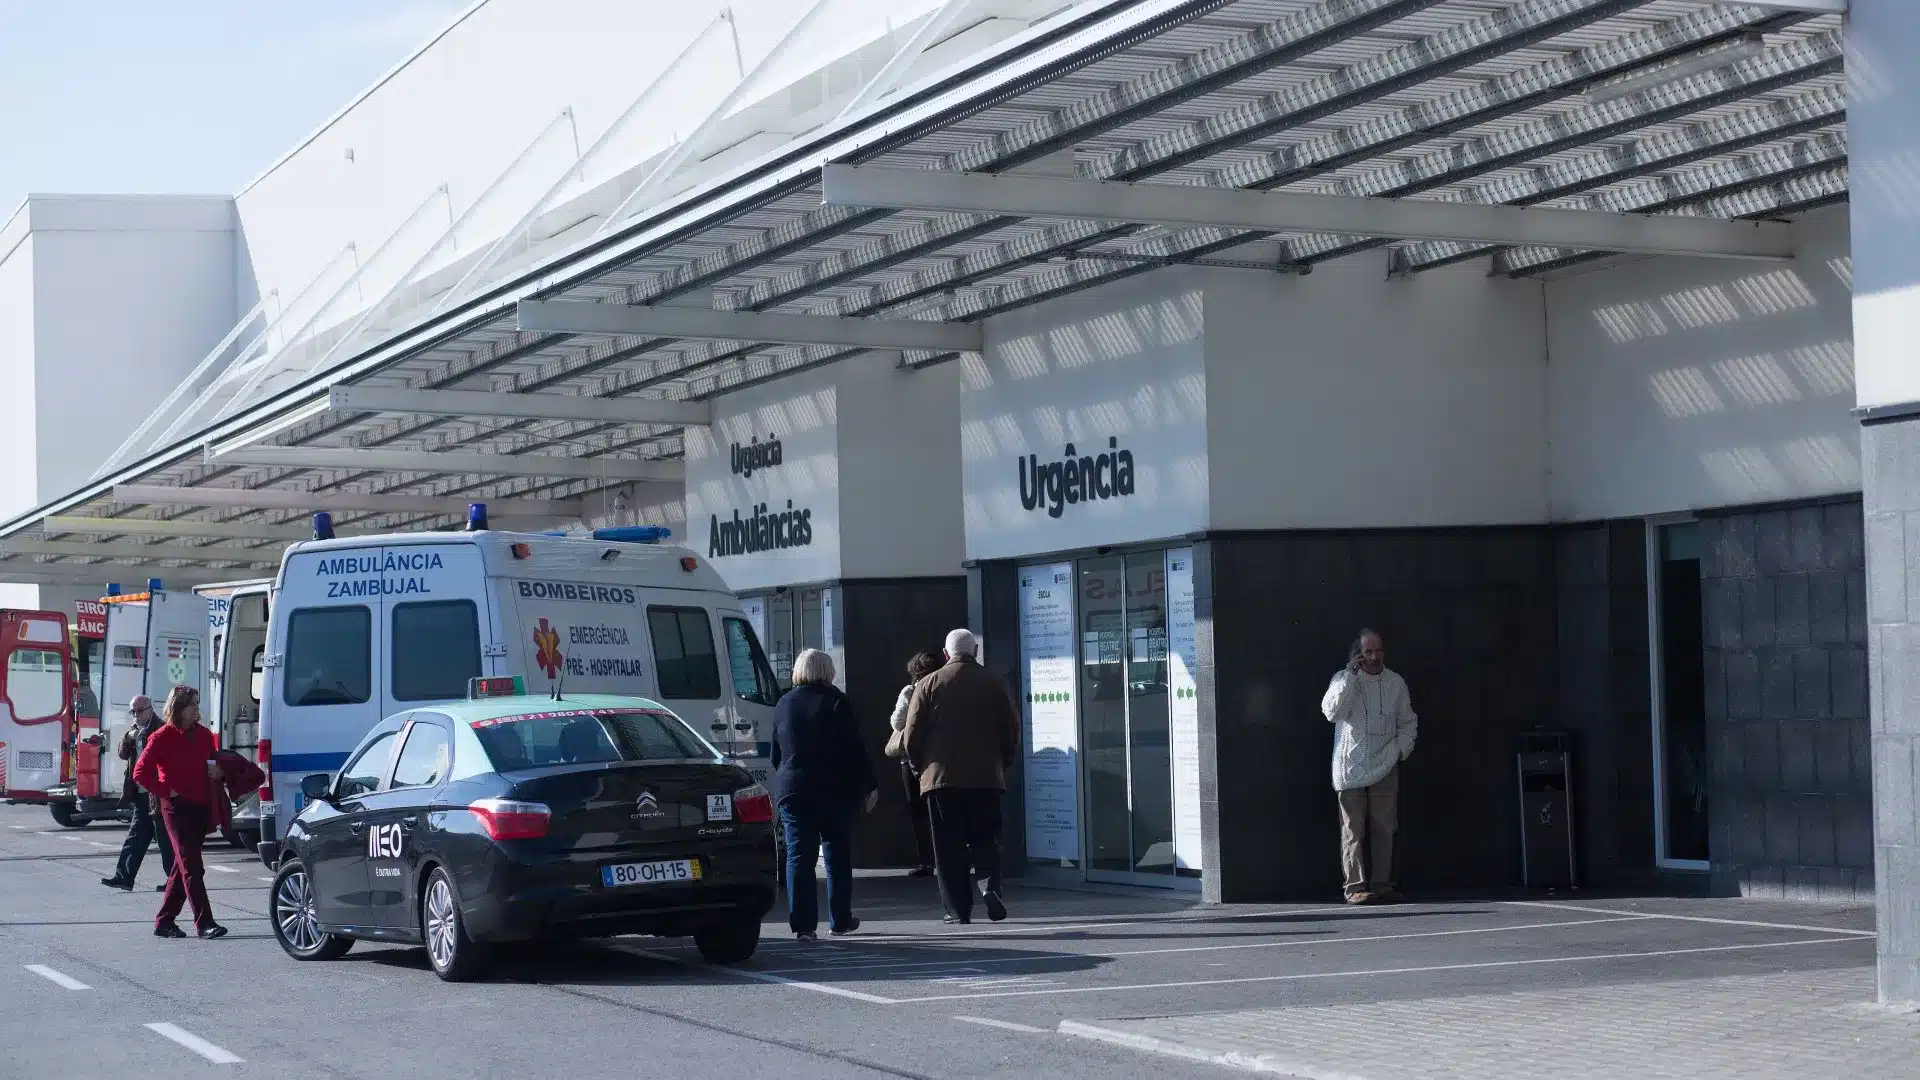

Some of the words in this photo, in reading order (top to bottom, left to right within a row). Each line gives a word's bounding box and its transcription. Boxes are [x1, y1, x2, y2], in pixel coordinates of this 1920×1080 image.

[731, 432, 782, 478] Urgência
[1019, 436, 1134, 518] Urgência
[709, 499, 811, 558] Ambulâncias
[317, 552, 443, 575] AMBULÂNCIA
[327, 577, 430, 598] ZAMBUJAL
[518, 582, 635, 603] BOMBEIROS
[76, 601, 107, 616] EIRO
[207, 598, 230, 612] EIR
[78, 618, 104, 634] ÂNC
[209, 615, 225, 628] RA
[569, 624, 630, 645] EMERGÊNCIA
[566, 654, 584, 675] PRÉ
[590, 658, 642, 676] HOSPITALAR
[714, 795, 724, 806] 21
[369, 823, 402, 858] MEO
